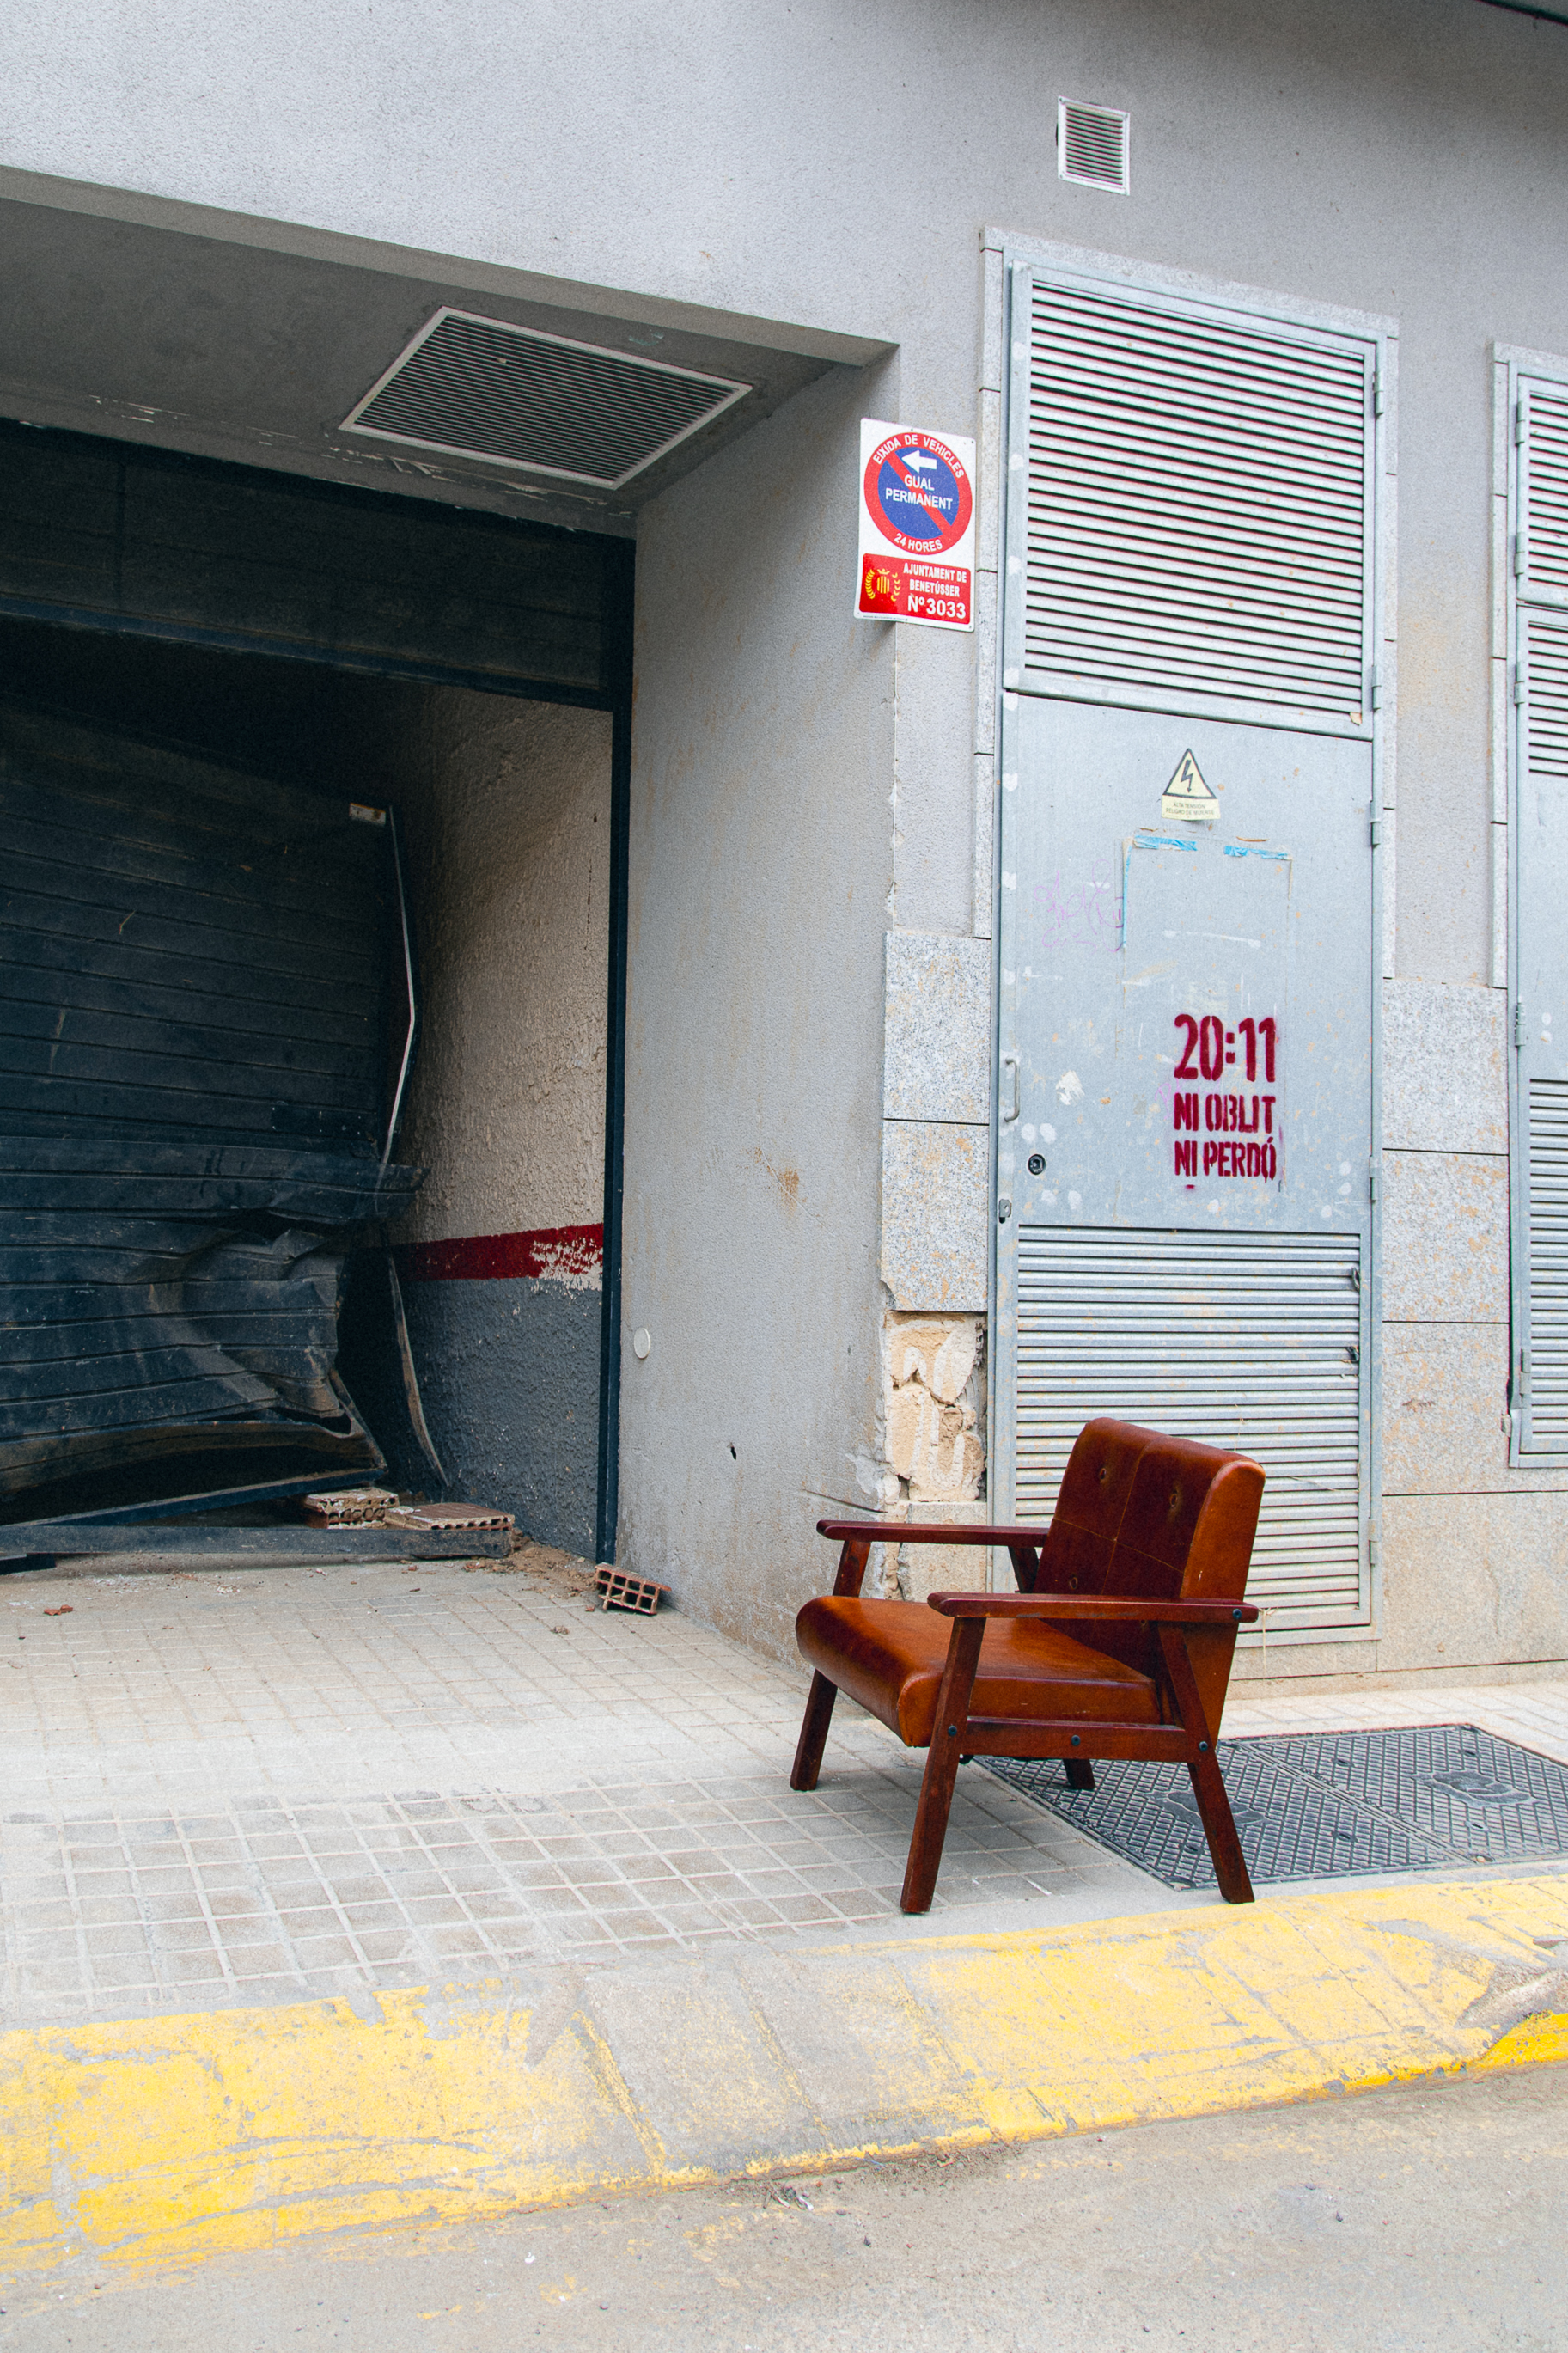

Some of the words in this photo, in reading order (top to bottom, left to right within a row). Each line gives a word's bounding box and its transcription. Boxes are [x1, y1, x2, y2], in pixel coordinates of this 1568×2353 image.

[872, 436, 901, 465] EIXIDA
[904, 434, 918, 445] DE
[923, 436, 964, 479] VEHICLES
[904, 474, 935, 491] GUAL
[885, 487, 953, 510] PERMANENT
[894, 533, 906, 547] 24
[907, 539, 943, 553] HORES
[903, 562, 955, 581] AJUNTAMENT
[956, 571, 967, 584] DE
[909, 578, 961, 597] BENETÚSSER
[926, 598, 967, 620] 3033
[1174, 1013, 1276, 1083] 20:11
[1174, 1092, 1199, 1132] NI
[1205, 1094, 1276, 1134] OBLIT
[1174, 1140, 1198, 1176] NI
[1203, 1136, 1277, 1183] PERDÓ
